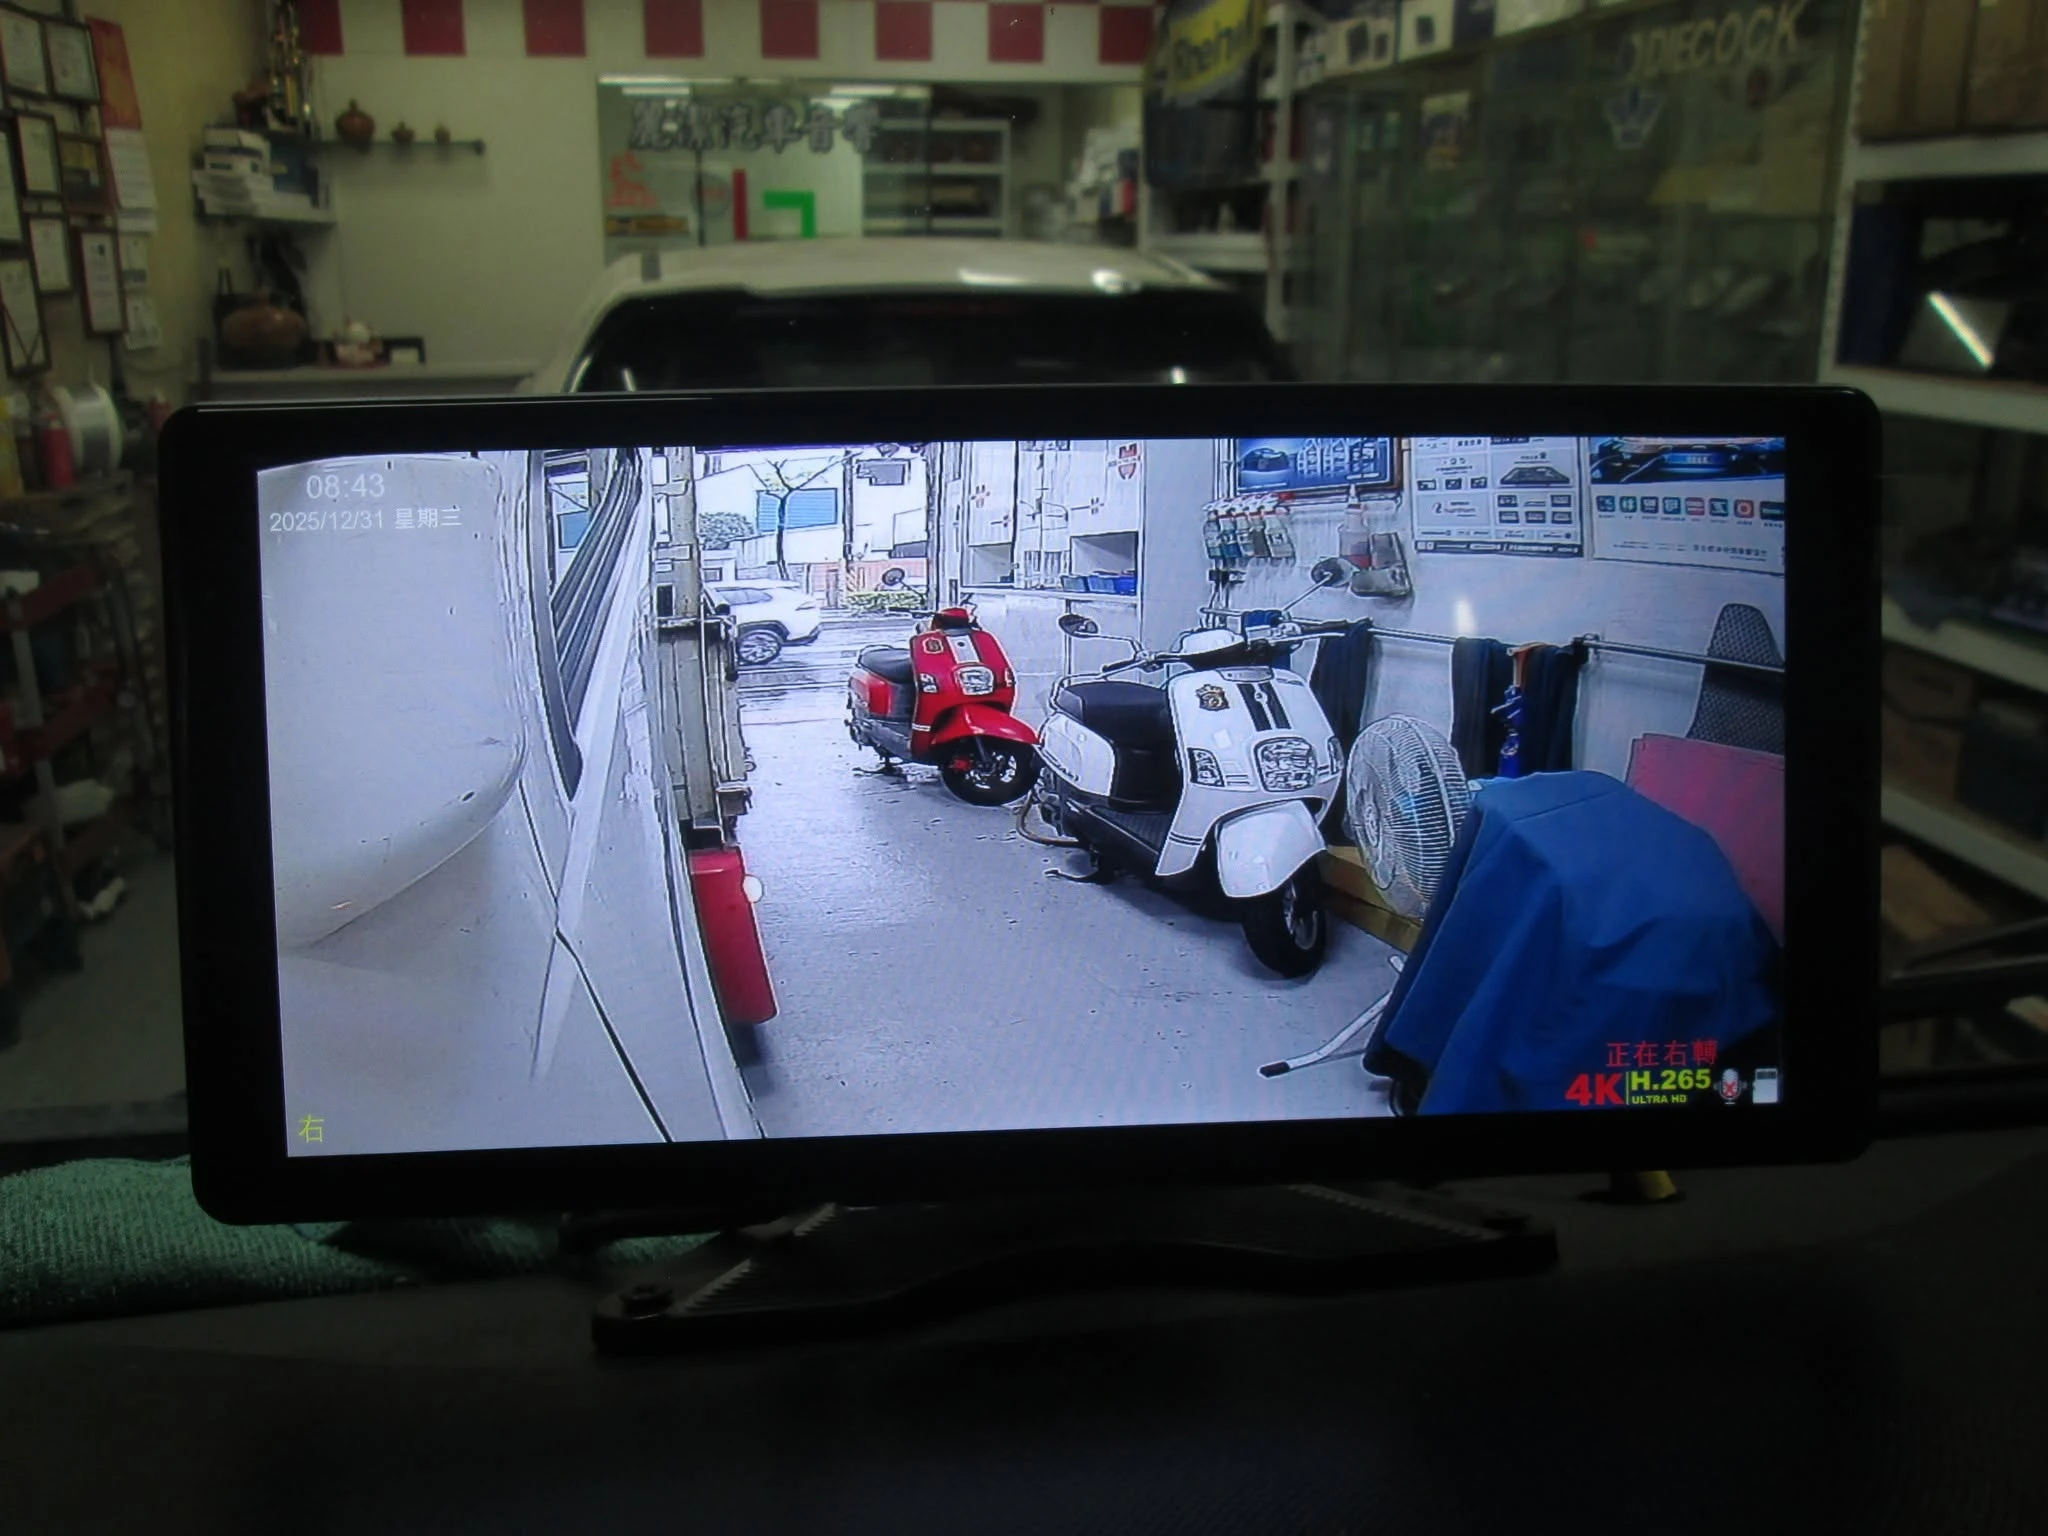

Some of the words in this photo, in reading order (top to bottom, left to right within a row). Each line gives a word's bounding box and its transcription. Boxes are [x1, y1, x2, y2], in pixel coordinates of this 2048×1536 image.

[306, 474, 385, 499] 08:43
[270, 510, 384, 532] 2025/12/31
[395, 507, 462, 529] 星期三
[1606, 1038, 1719, 1068] 正在右轉
[1565, 1072, 1625, 1106] 4K
[1631, 1069, 1711, 1091] H.265
[1631, 1095, 1669, 1105] ULTRA
[1671, 1094, 1687, 1104] HD
[299, 1113, 324, 1142] 右
